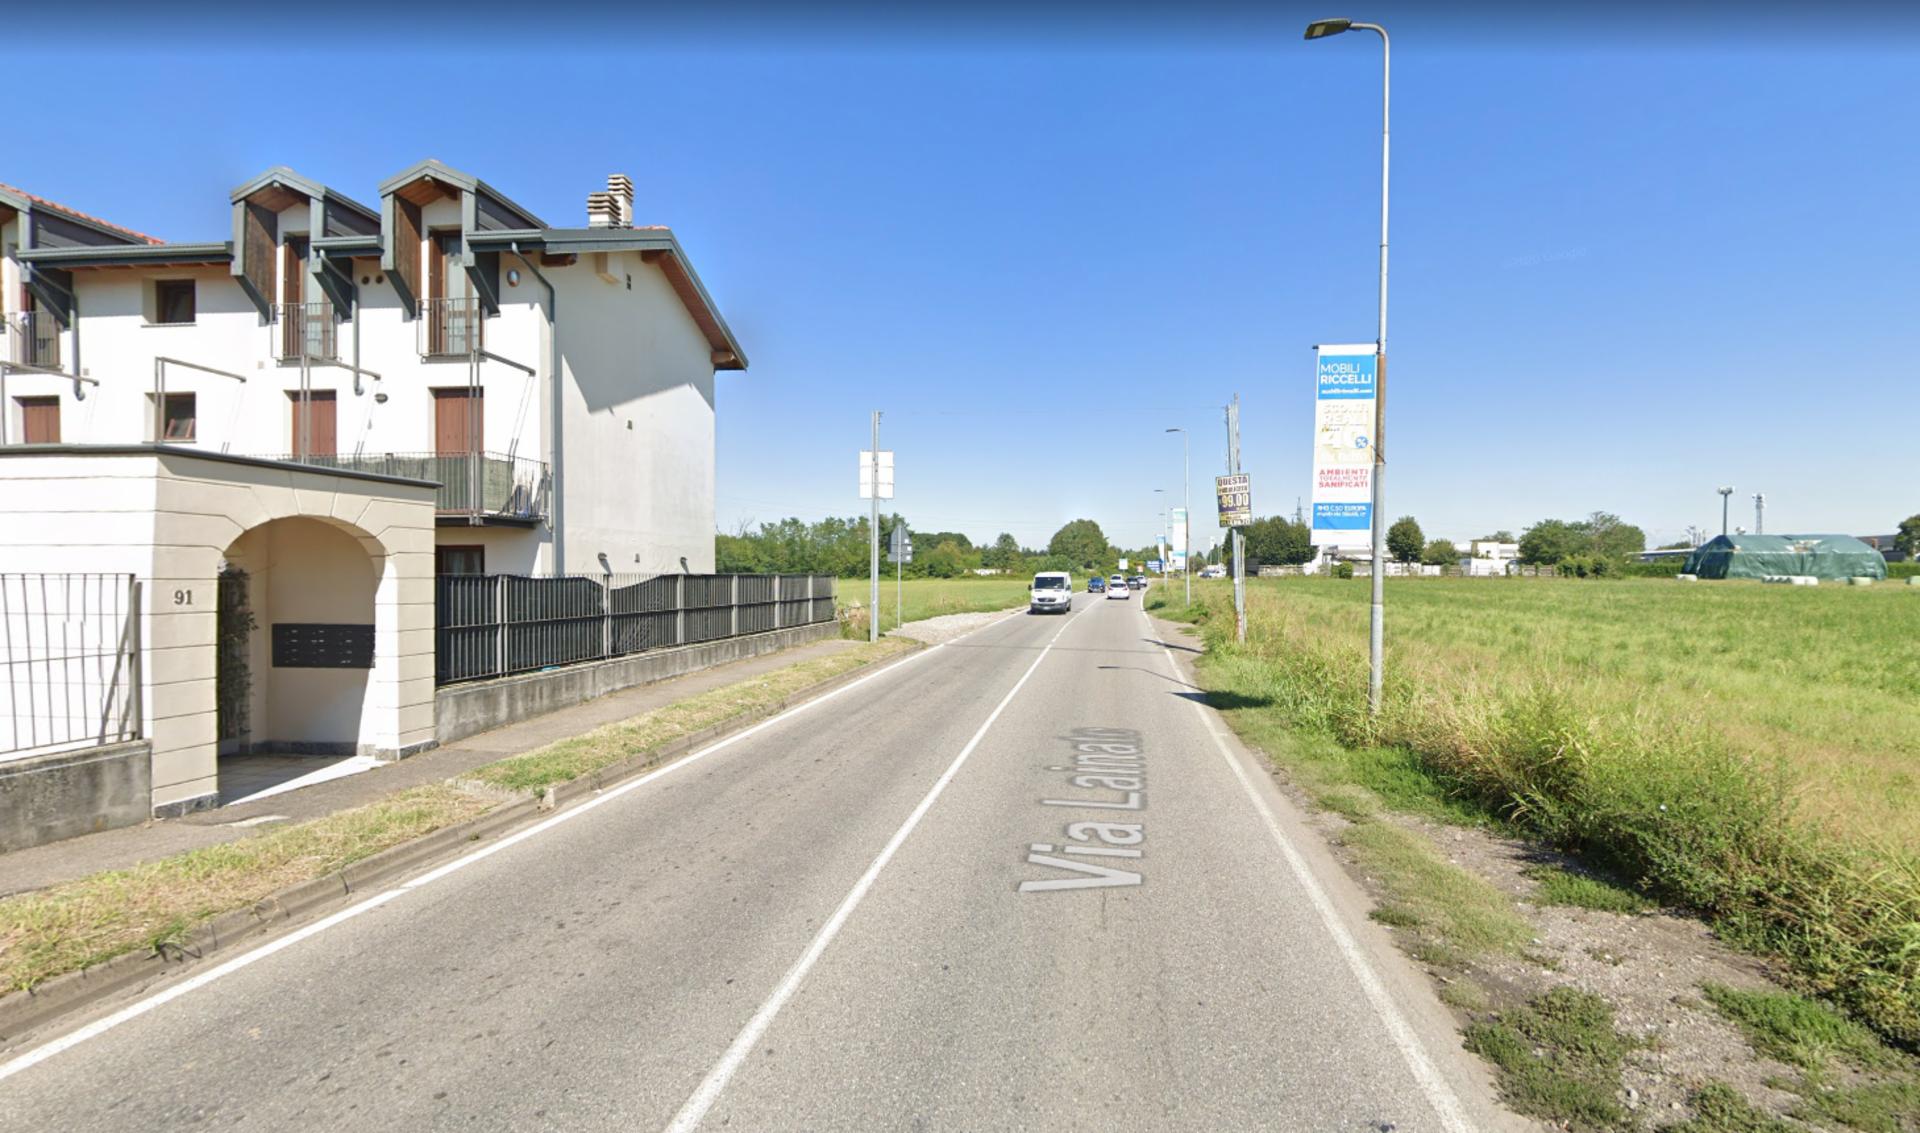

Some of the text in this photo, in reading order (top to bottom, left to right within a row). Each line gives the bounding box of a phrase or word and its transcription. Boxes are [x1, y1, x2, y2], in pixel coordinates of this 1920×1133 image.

[1320, 363, 1360, 373] MOBILI
[1320, 374, 1372, 384] RICCELLI
[1218, 476, 1247, 486] QUESTA
[174, 589, 193, 605] 91
